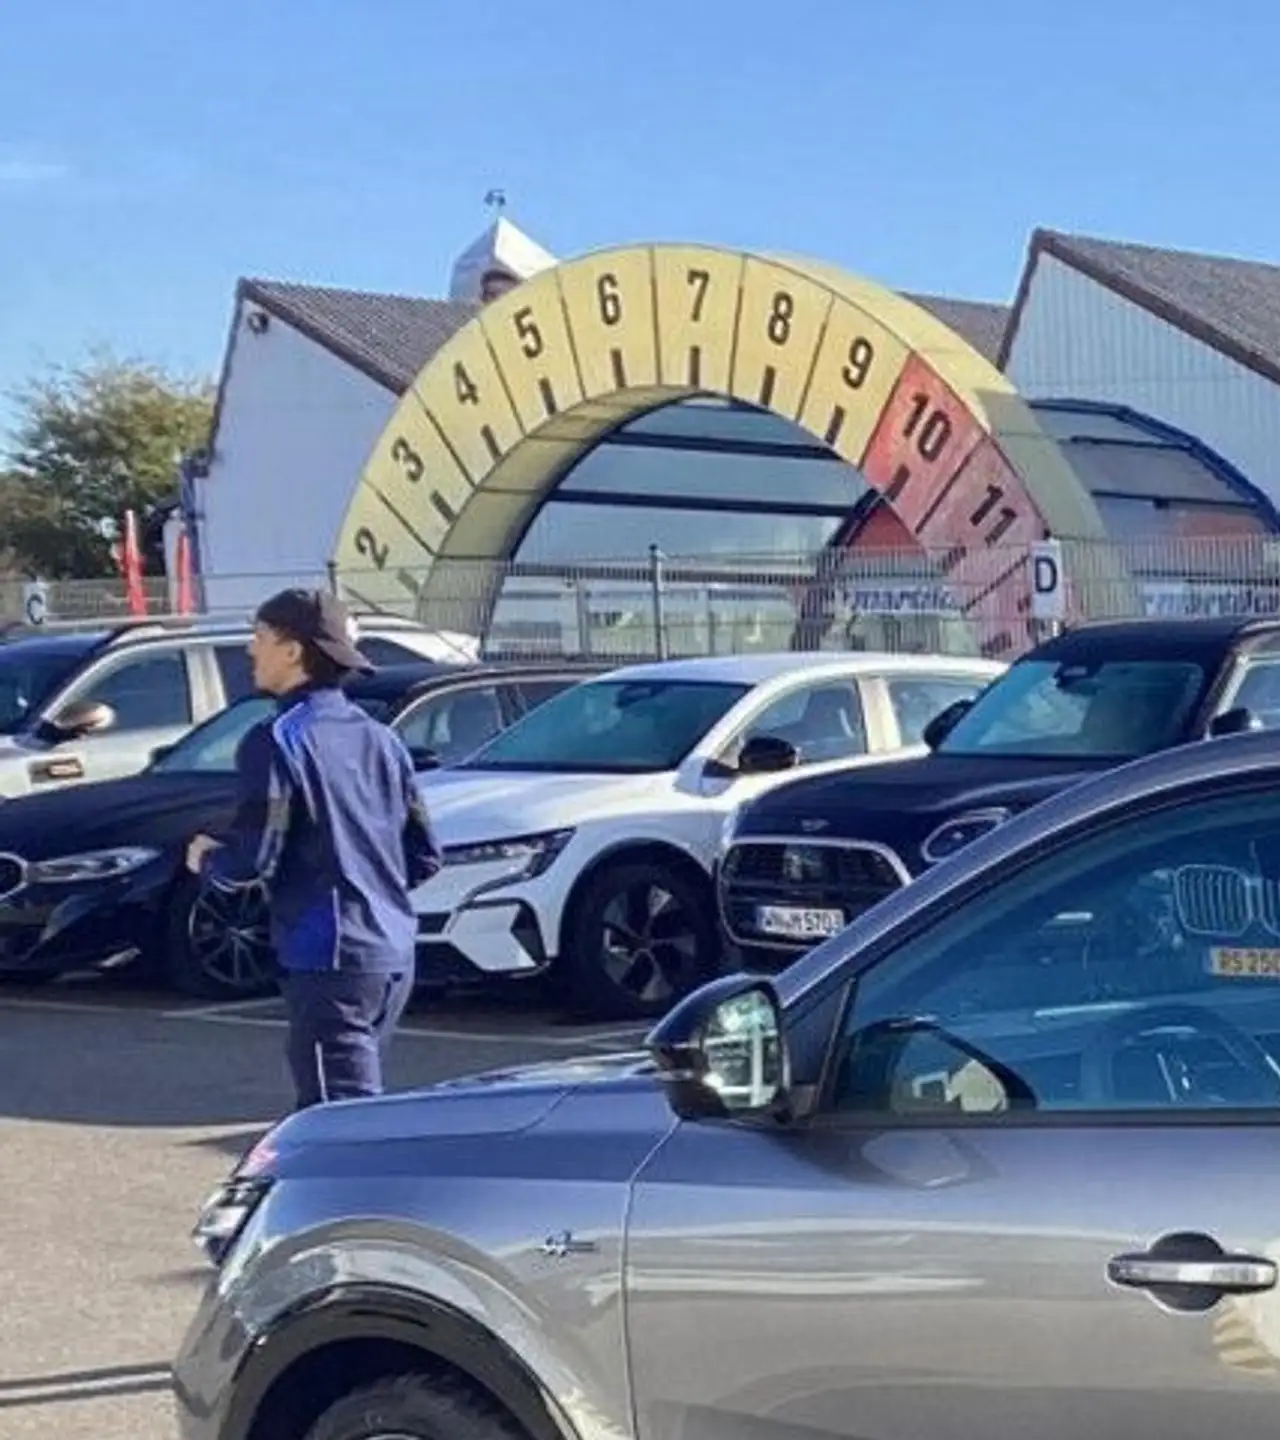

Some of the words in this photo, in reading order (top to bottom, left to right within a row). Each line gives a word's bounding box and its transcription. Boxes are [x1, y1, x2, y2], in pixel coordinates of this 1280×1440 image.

[353, 526, 389, 571] 2
[390, 436, 426, 483] 3
[452, 361, 480, 406] 4
[512, 307, 544, 359] 5
[597, 273, 621, 326] 6
[687, 269, 710, 323] 7
[768, 291, 794, 345] 8
[842, 336, 874, 390] 9
[903, 393, 952, 463] 10
[970, 483, 1018, 547] 11
[1033, 555, 1058, 594] D
[27, 592, 44, 625] C
